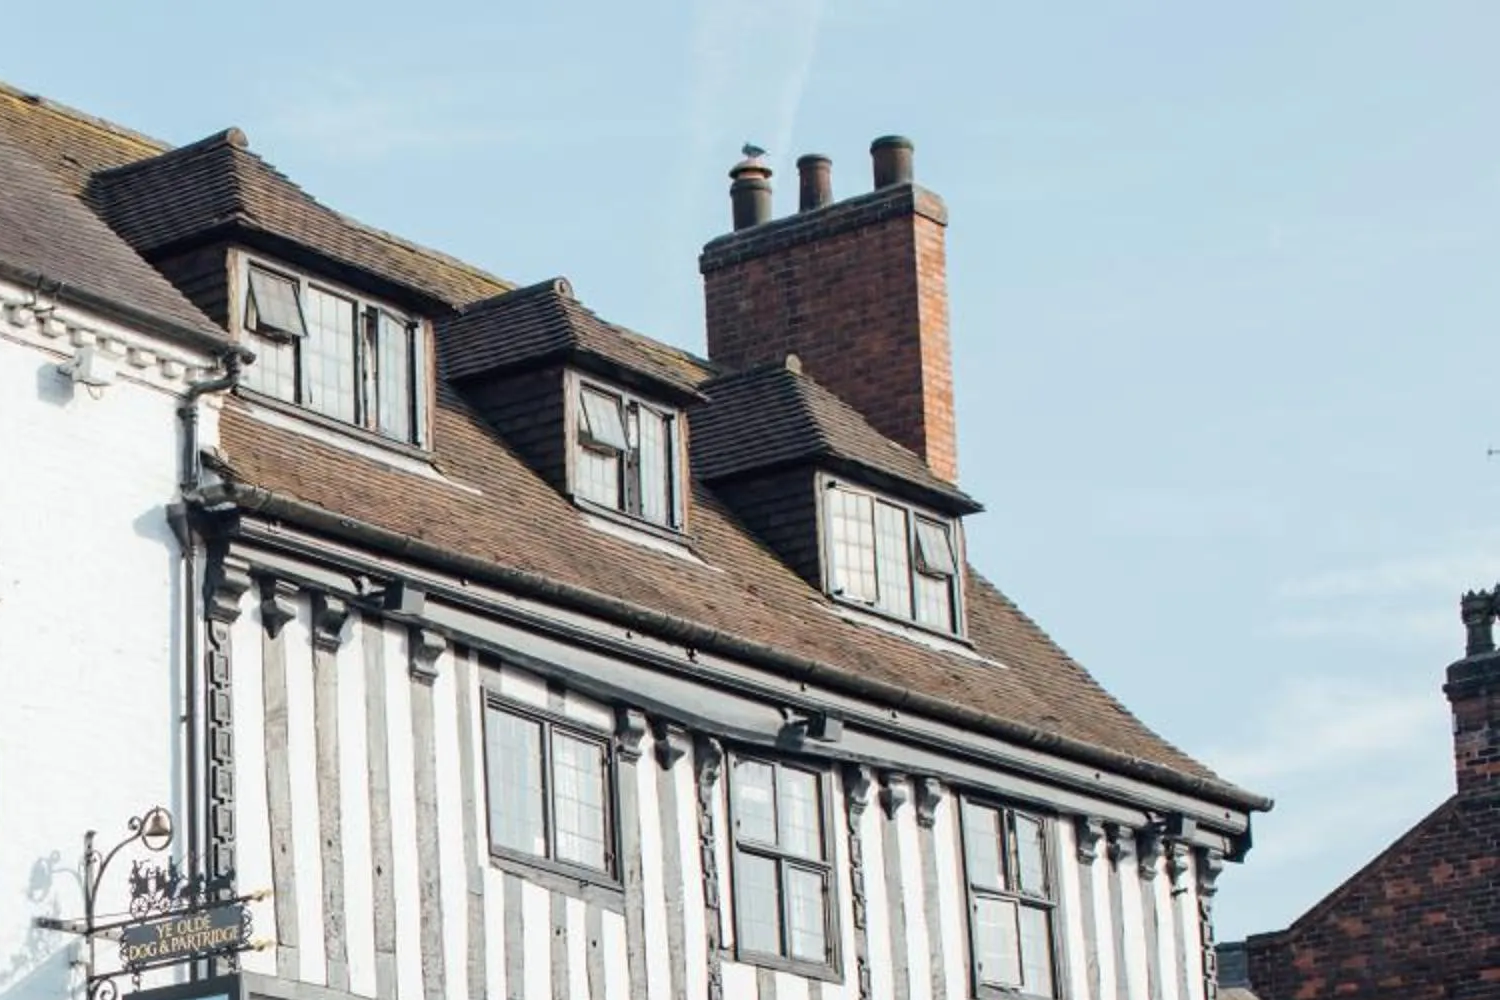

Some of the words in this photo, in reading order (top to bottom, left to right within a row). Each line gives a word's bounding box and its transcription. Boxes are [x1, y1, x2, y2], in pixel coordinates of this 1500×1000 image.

[156, 923, 173, 938] YE
[177, 913, 211, 935] OLDE
[129, 941, 157, 960] DOG
[160, 940, 170, 954] &
[171, 925, 238, 953] PARTRIDGE
